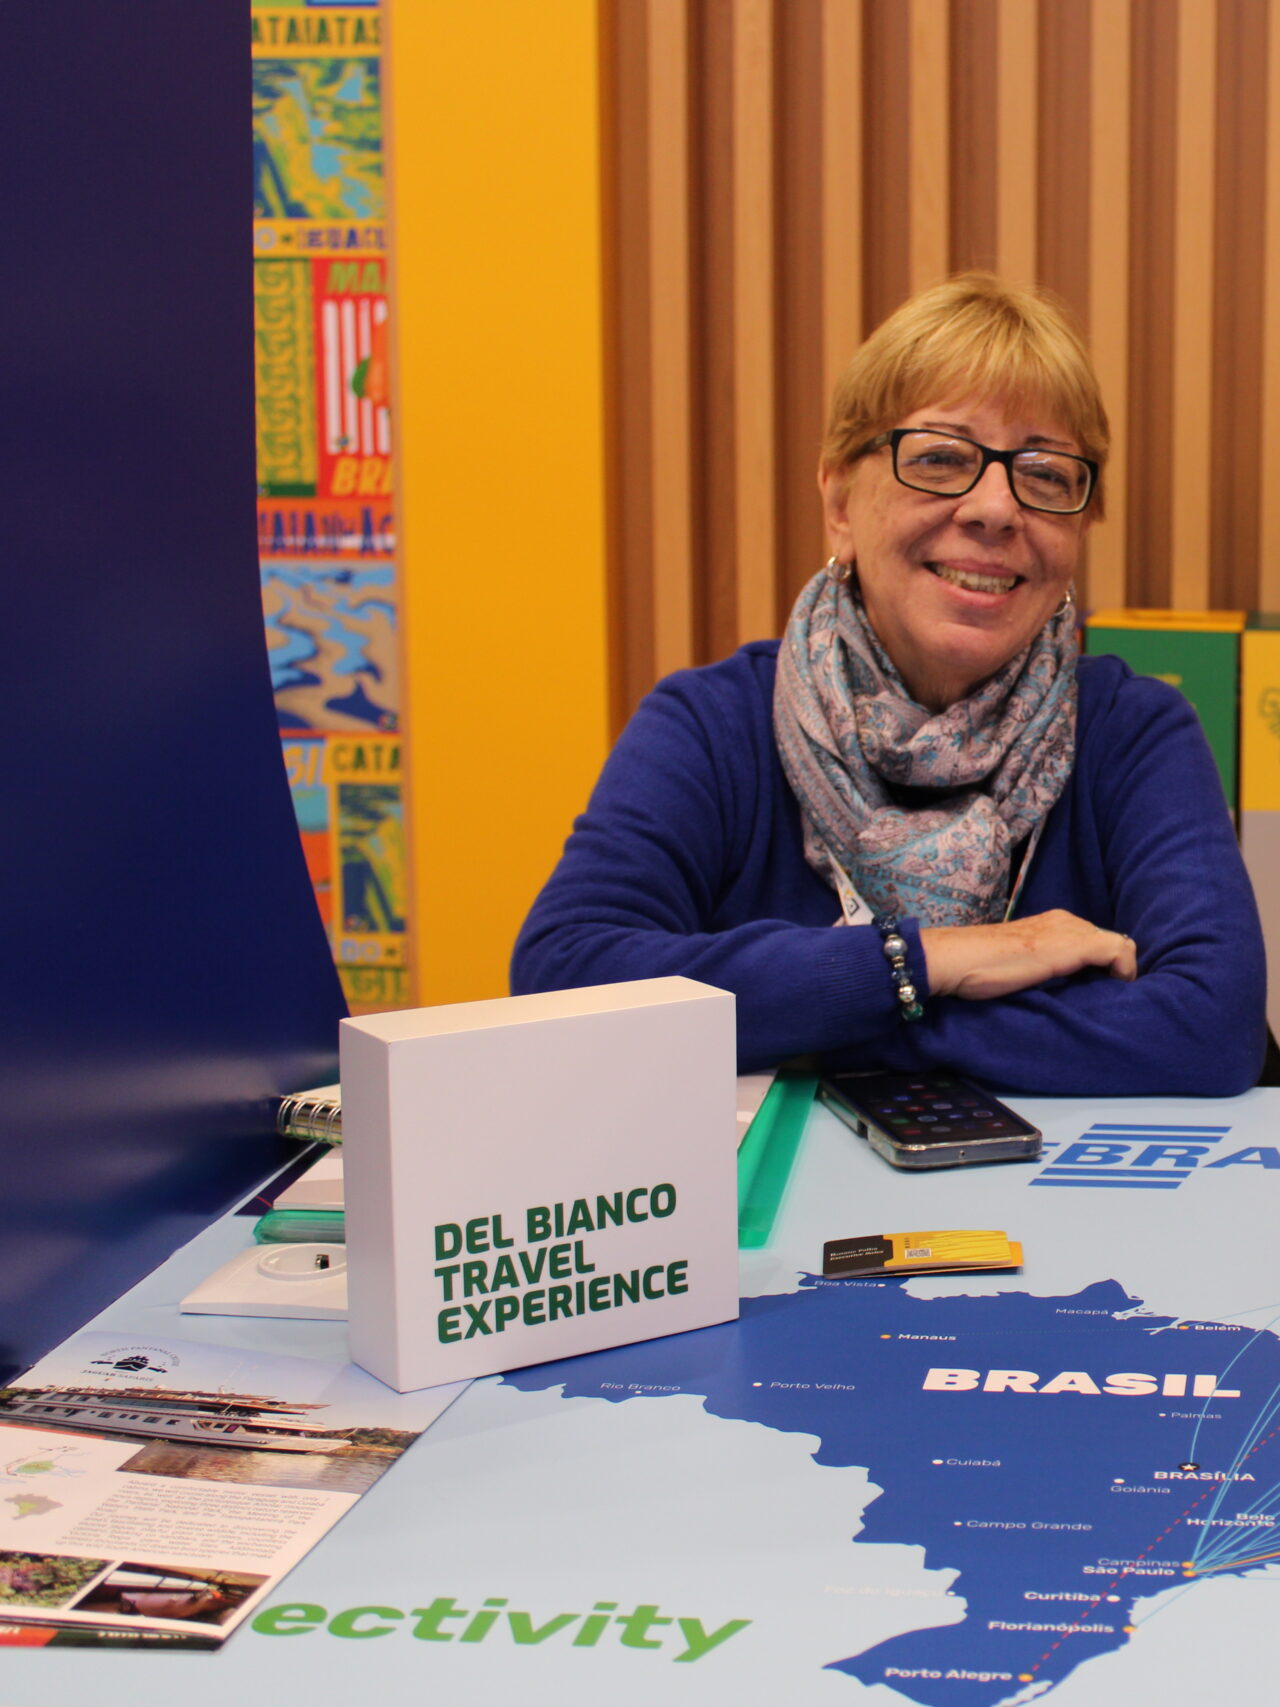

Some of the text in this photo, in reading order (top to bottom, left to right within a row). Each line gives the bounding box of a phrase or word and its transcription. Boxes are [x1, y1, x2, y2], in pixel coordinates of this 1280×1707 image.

[434, 1182, 677, 1261] DEL BIANCO
[434, 1239, 596, 1302] TRAVEL
[437, 1259, 689, 1344] EXPERIENCE
[1055, 1308, 1109, 1317] Macapá
[1194, 1323, 1241, 1332] Belém
[897, 1333, 957, 1341] Manaus
[601, 1382, 681, 1391] Rio Branco
[770, 1381, 856, 1390] Porto Velho
[922, 1368, 1241, 1398] BRASIL
[946, 1458, 1002, 1467] Cuiabá
[1154, 1470, 1256, 1482] BRASÍLIA
[1110, 1485, 1171, 1494] Goiânia
[1236, 1512, 1275, 1521] Belo
[966, 1520, 1093, 1531] Campo Grande
[1187, 1518, 1275, 1527] Horizonte
[1097, 1558, 1180, 1568] Campinas
[1083, 1566, 1175, 1576] São Paulo
[1024, 1592, 1101, 1602] Curitiba
[250, 1597, 754, 1663] ectivity
[987, 1620, 1115, 1634] Florianópolis
[885, 1668, 1013, 1682] Porto Alegre
